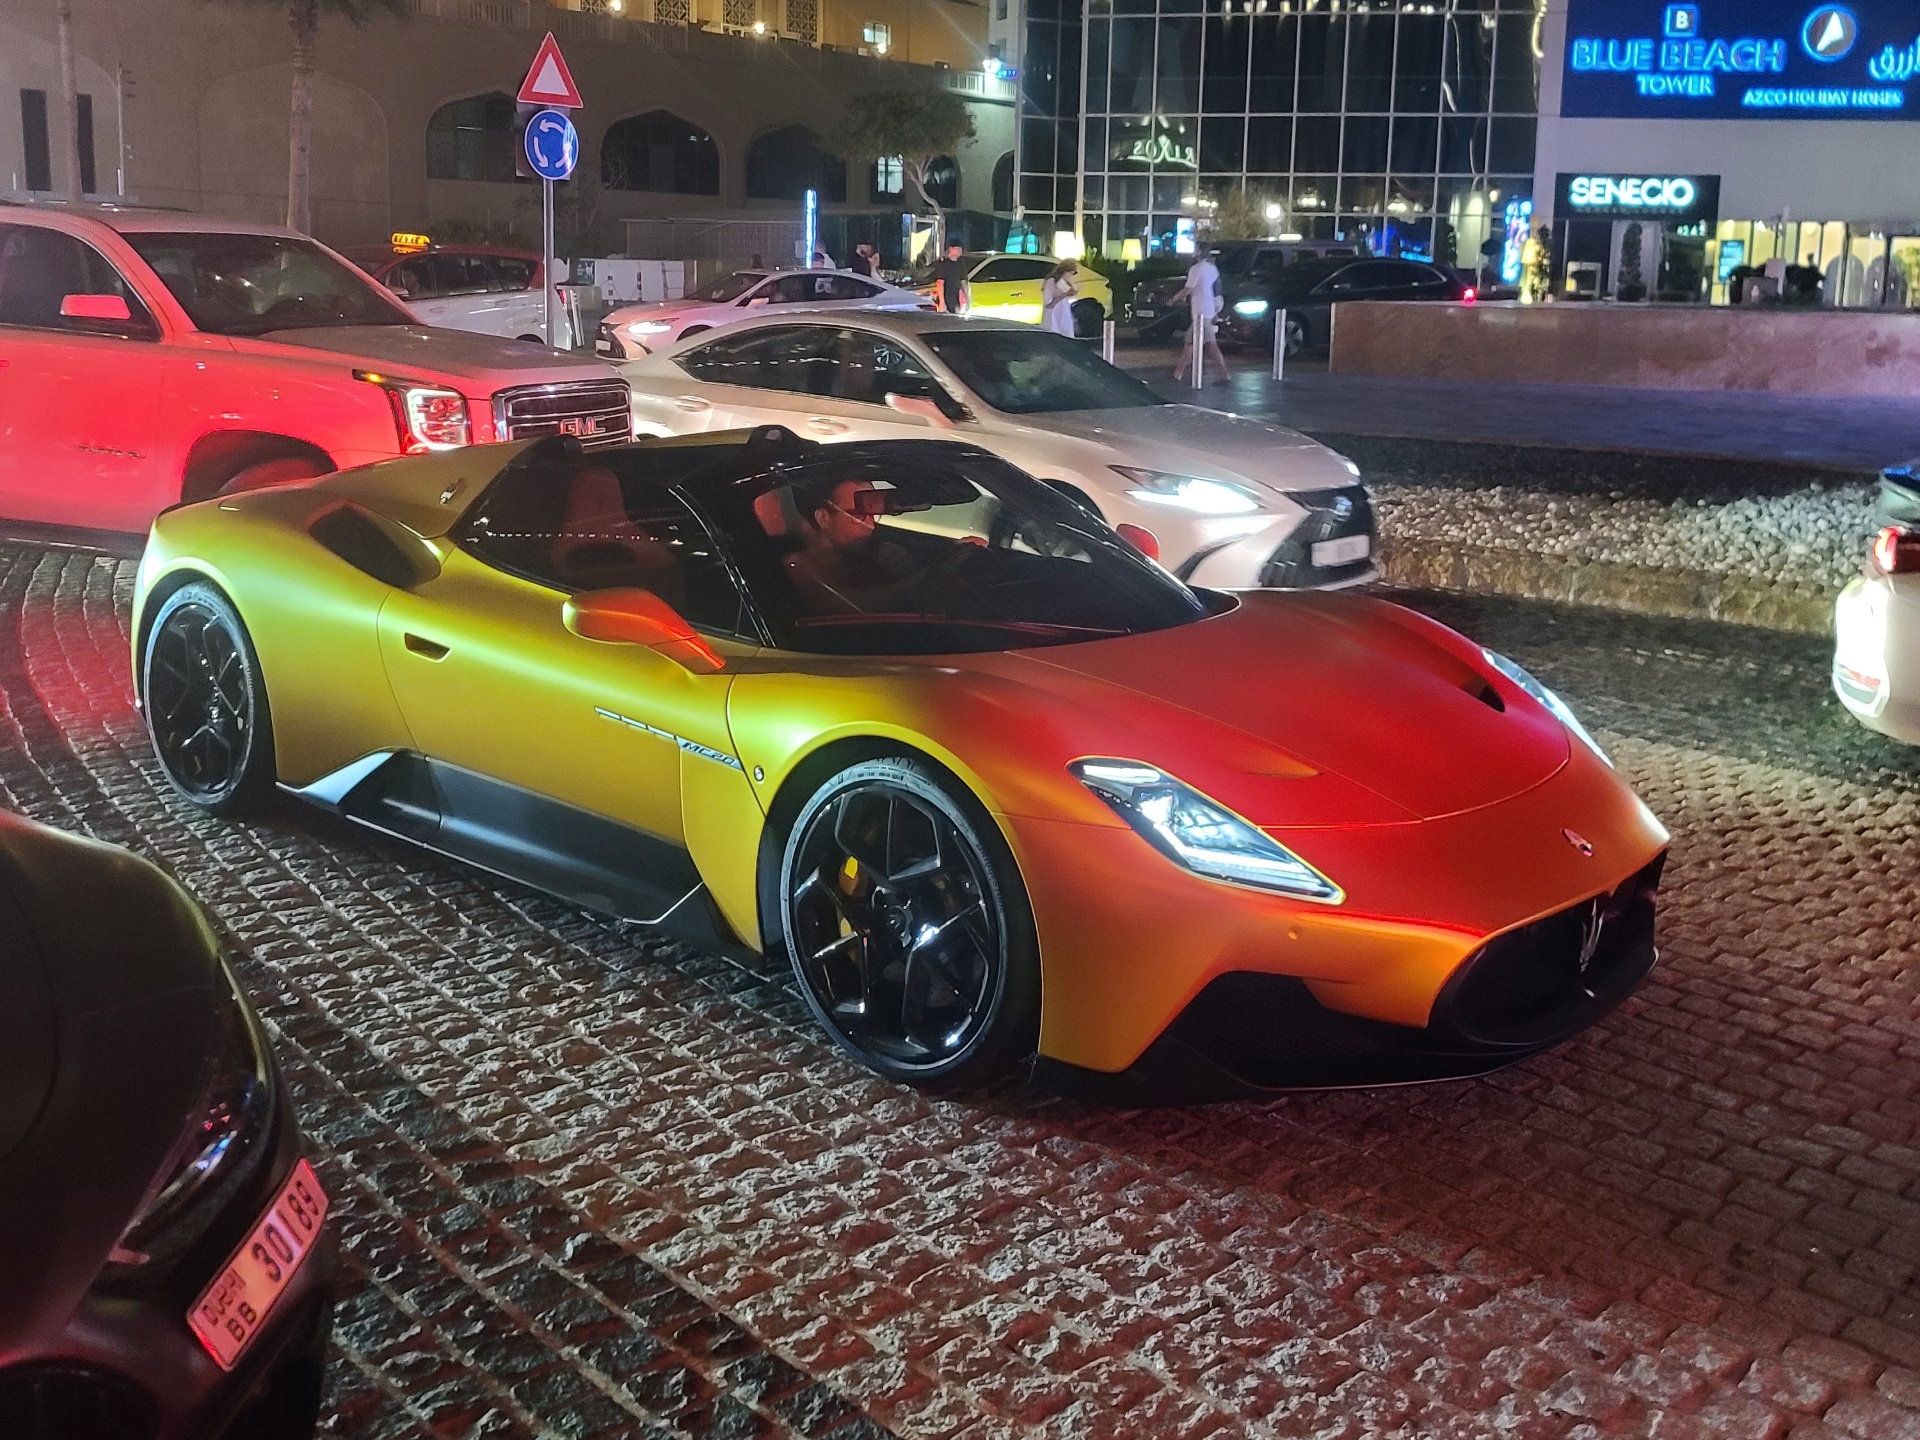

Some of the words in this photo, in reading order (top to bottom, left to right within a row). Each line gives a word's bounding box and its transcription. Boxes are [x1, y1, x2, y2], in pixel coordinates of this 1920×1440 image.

[1675, 10, 1689, 30] B
[1572, 39, 1655, 71] BLUE
[1660, 39, 1787, 72] BEACH
[1638, 74, 1714, 96] TOWER
[1743, 88, 1788, 106] AZCO
[1789, 88, 1849, 106] HOLIDAY
[1852, 88, 1903, 107] HOMES
[1570, 177, 1695, 207] SENECIO
[394, 234, 420, 244] TAXI
[560, 415, 606, 436] GMC
[681, 742, 735, 765] MC20
